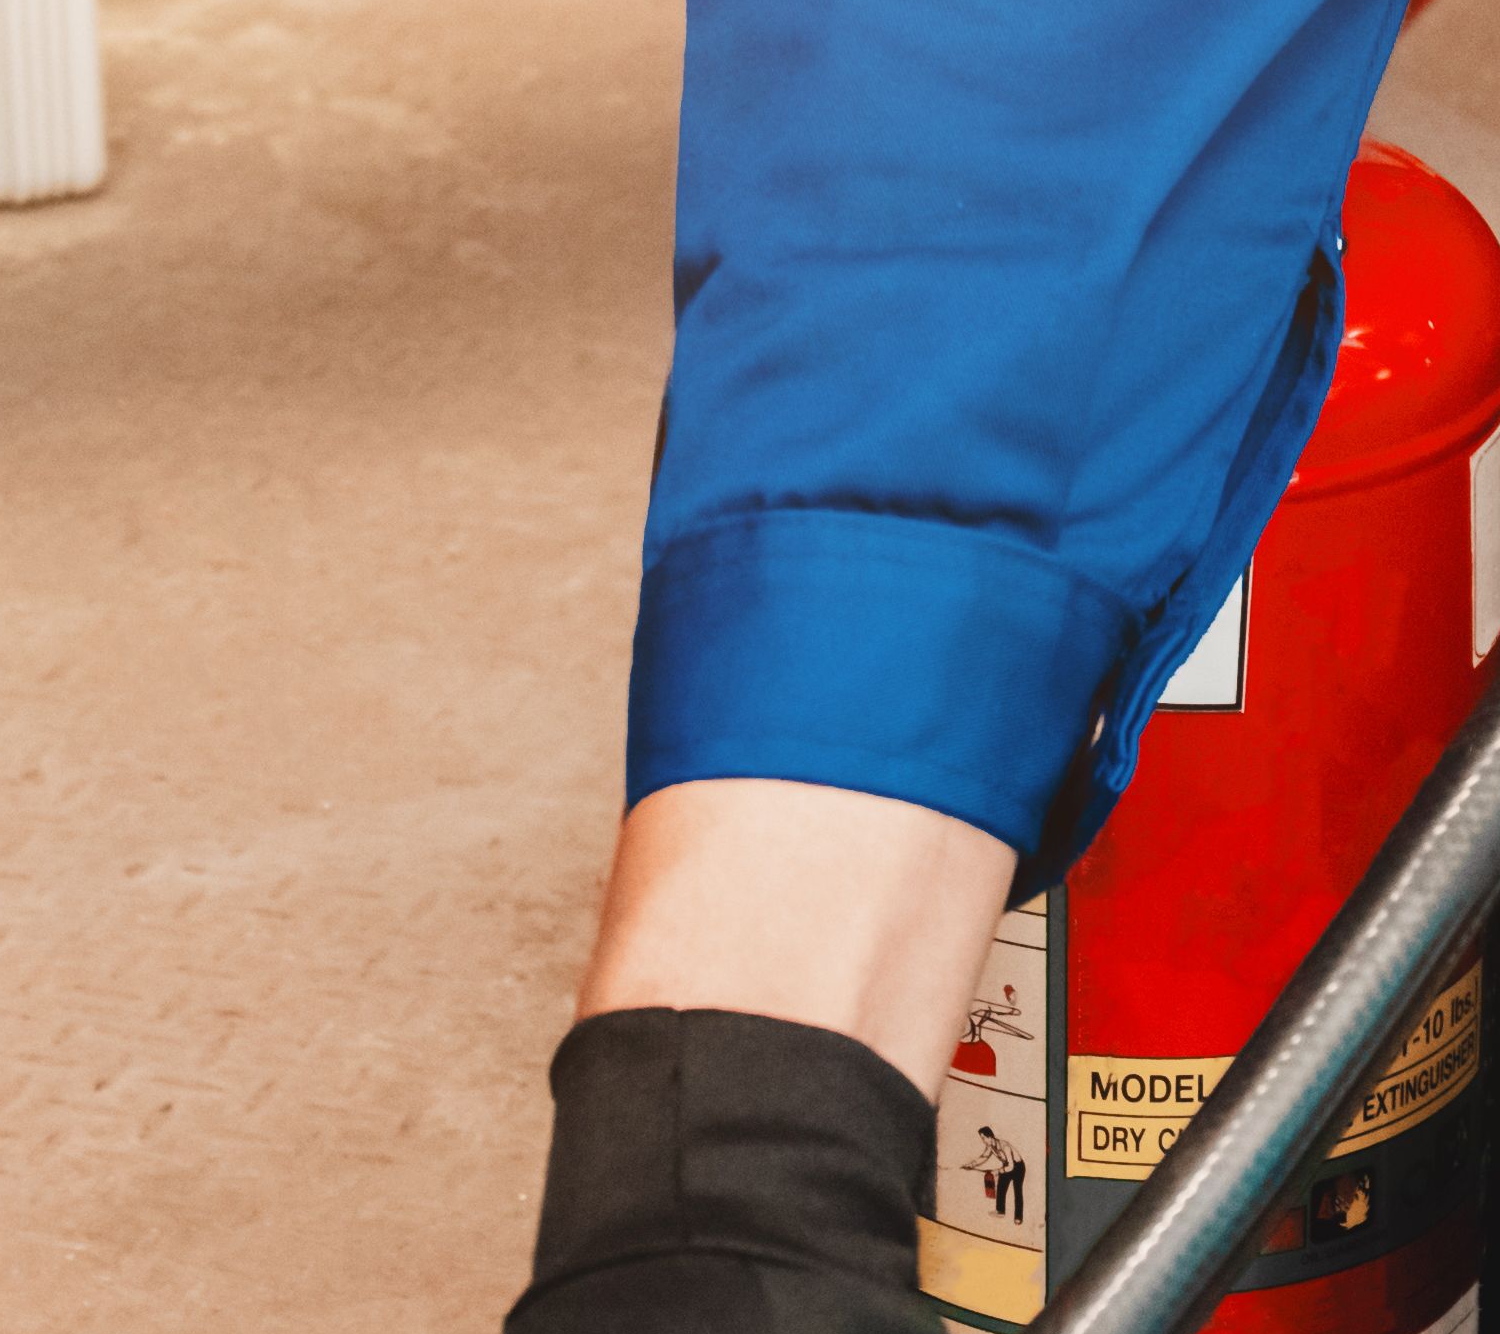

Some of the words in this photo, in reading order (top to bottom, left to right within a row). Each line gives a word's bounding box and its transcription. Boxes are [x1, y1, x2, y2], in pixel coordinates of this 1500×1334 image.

[1091, 1071, 1209, 1103] MODEL
[1093, 1125, 1146, 1152] DRY
[1363, 1031, 1475, 1122] EXTINGUISHER
